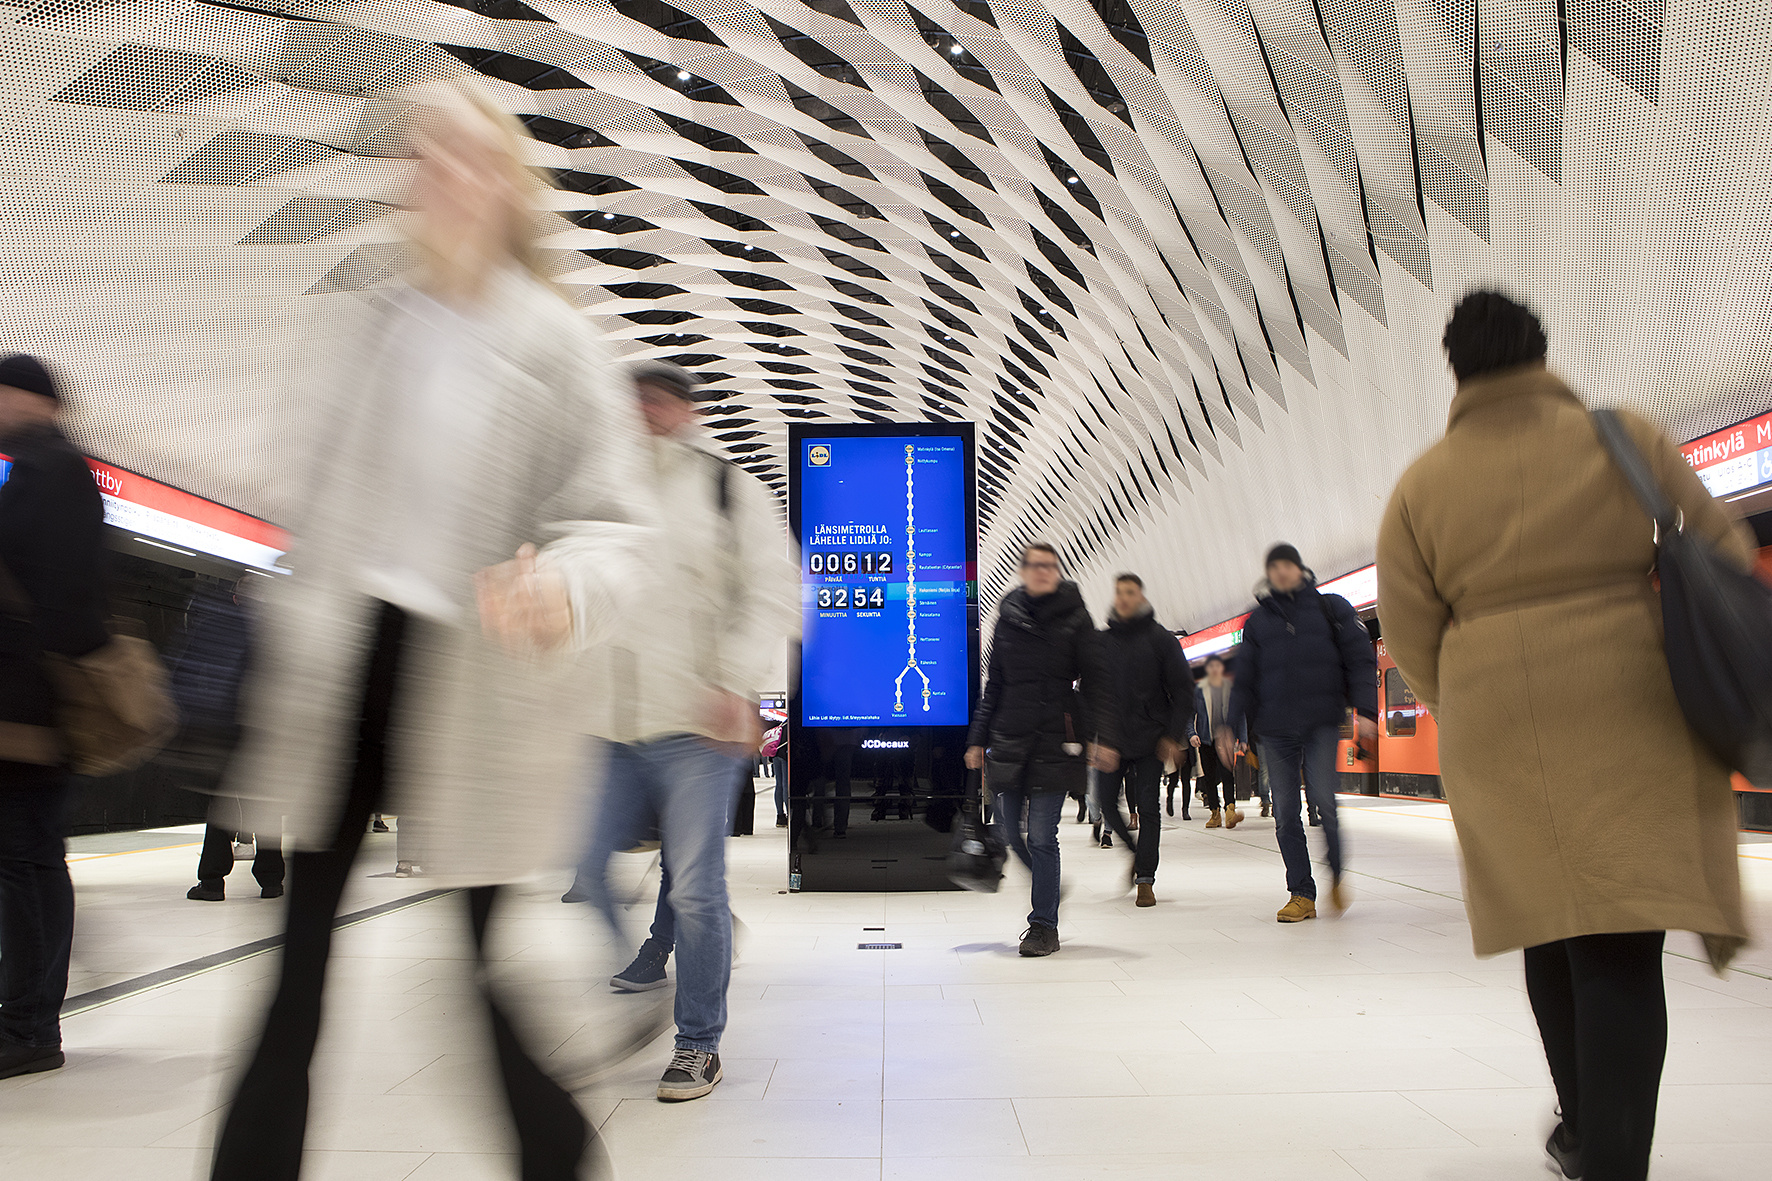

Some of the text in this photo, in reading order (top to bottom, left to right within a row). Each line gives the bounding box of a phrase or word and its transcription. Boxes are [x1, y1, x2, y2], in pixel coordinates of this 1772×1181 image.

[1681, 430, 1745, 467] atinkylä
[814, 523, 887, 535] LÄNSIMETROLLA
[809, 533, 893, 545] LÄHELLE LIDLIÄ JO:
[861, 739, 909, 749] JCDecaux
